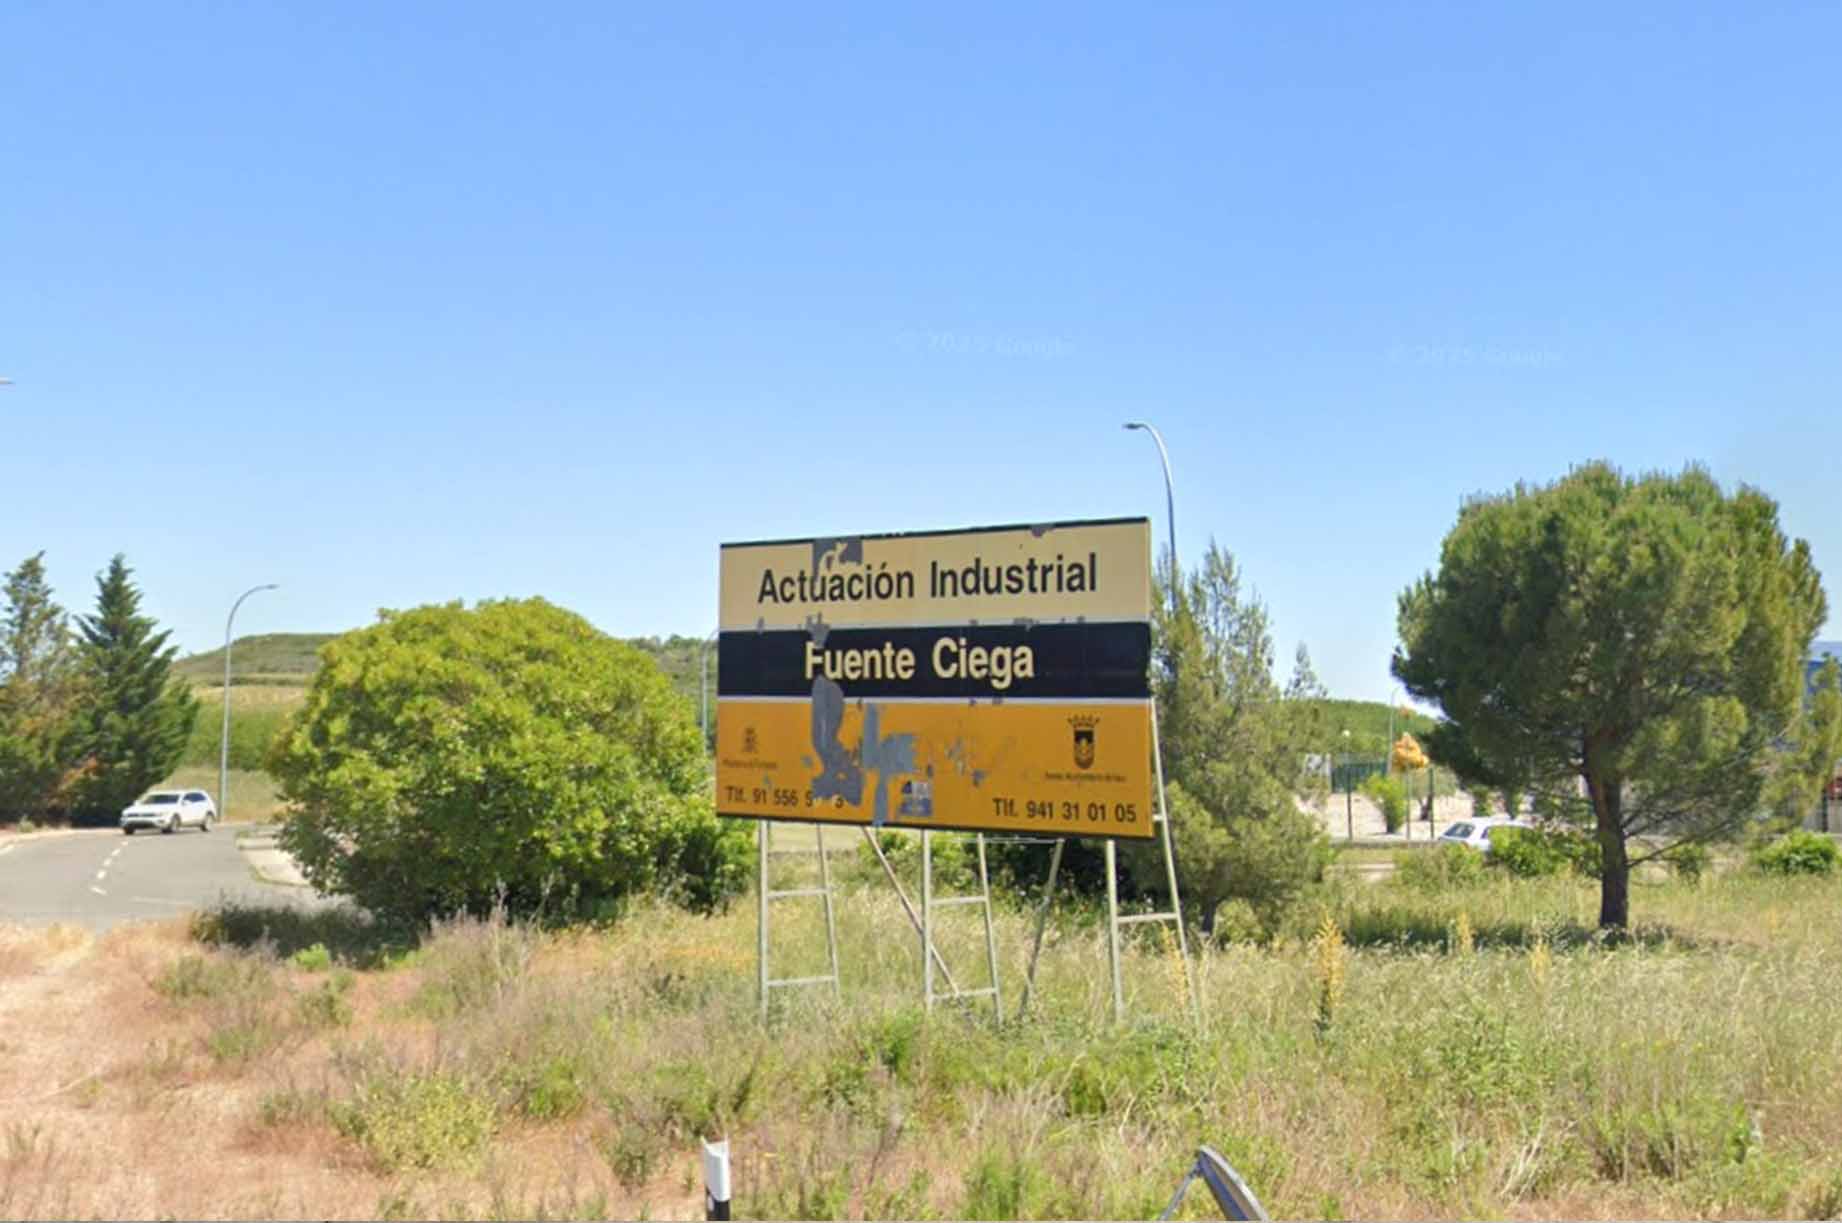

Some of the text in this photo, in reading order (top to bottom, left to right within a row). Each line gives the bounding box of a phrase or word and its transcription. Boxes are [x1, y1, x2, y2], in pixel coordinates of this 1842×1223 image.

[758, 553, 1097, 604] Actuación Industrial
[805, 636, 1035, 689] Fuente Ciega
[753, 787, 767, 804] 91
[1025, 800, 1054, 820] 941
[1062, 801, 1081, 821] 31
[1087, 802, 1107, 822] 01
[1114, 803, 1137, 823] 05
